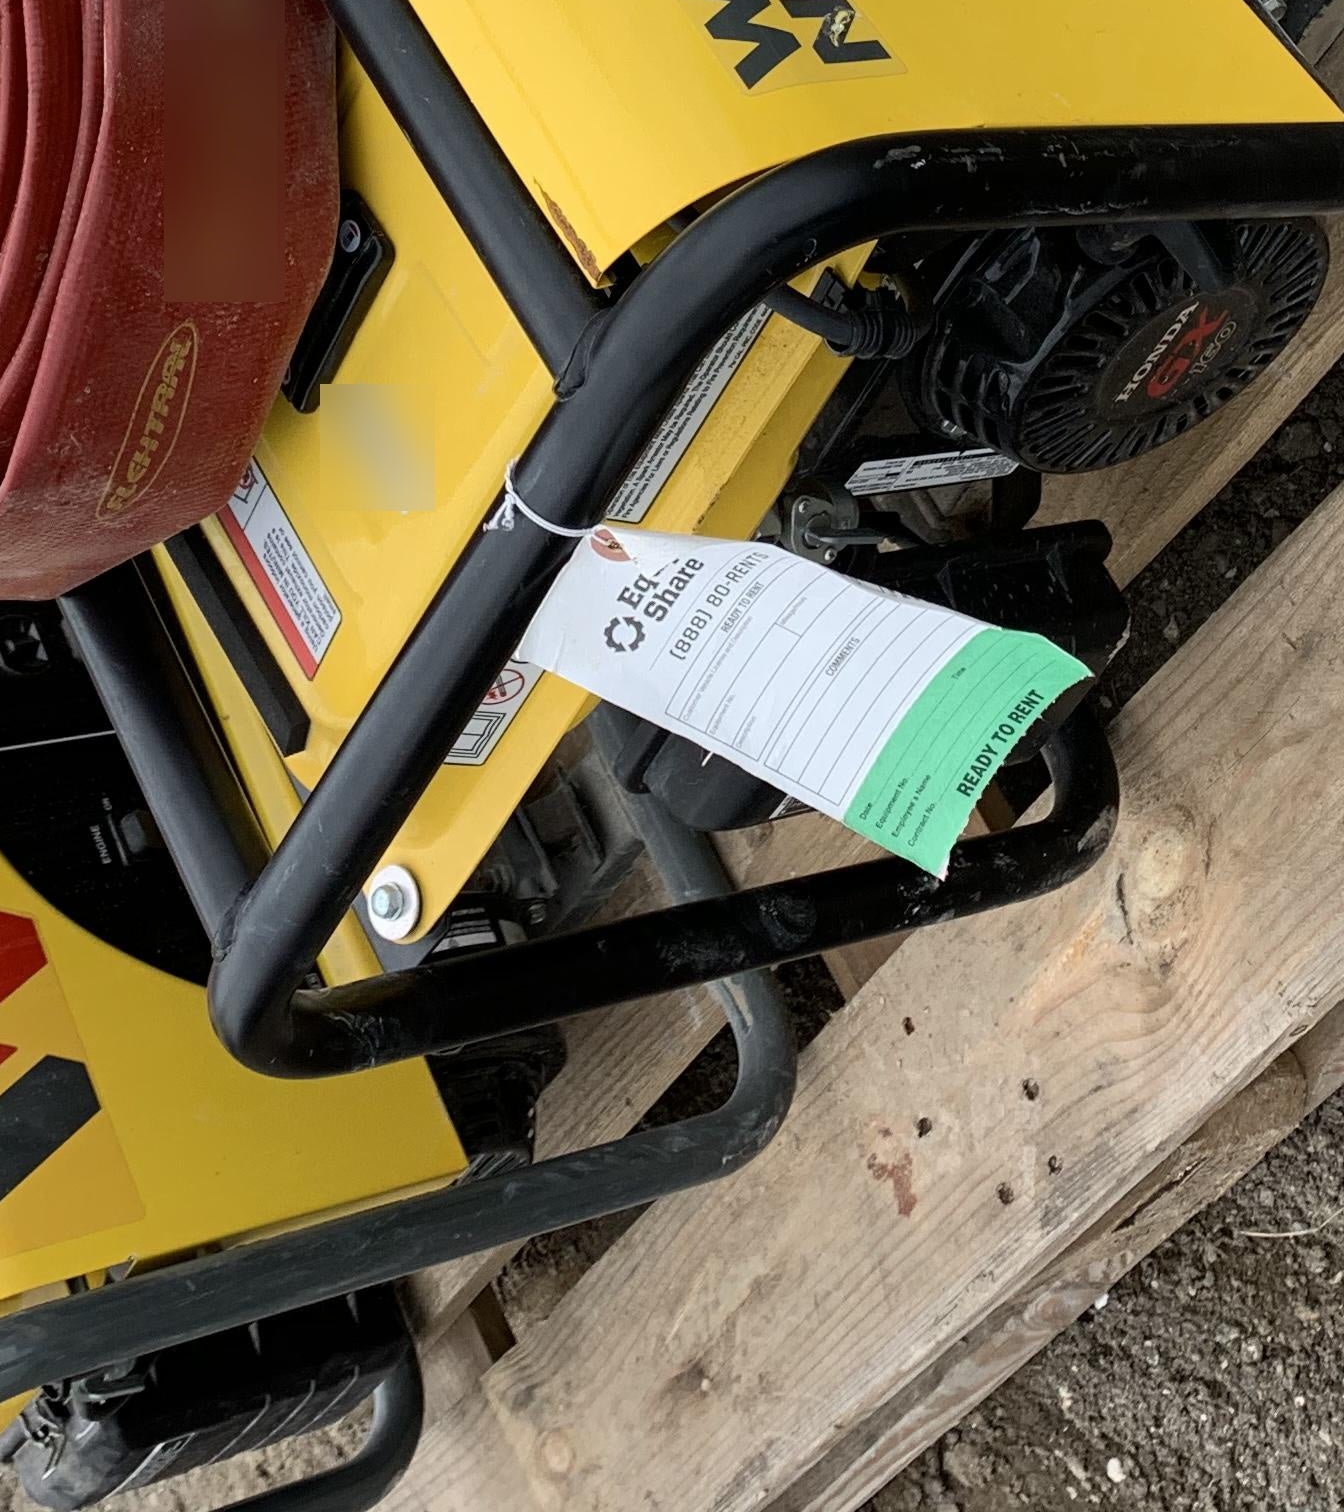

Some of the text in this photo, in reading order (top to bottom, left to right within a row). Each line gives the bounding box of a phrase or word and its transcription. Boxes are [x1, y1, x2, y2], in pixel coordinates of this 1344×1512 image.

[1115, 301, 1200, 402] HONDA
[1146, 305, 1229, 398] GX
[1189, 321, 1237, 375] 160
[643, 558, 704, 622] Share
[669, 552, 769, 660] (888) 80-RENTS
[721, 581, 765, 633] READY TO RENT
[824, 637, 860, 676] COMMENTS
[956, 688, 1044, 798] READY TO RENT
[874, 788, 903, 830] Equipment
[915, 772, 932, 796] Name
[90, 823, 113, 864] ENGINE
[907, 813, 931, 848] Contract
